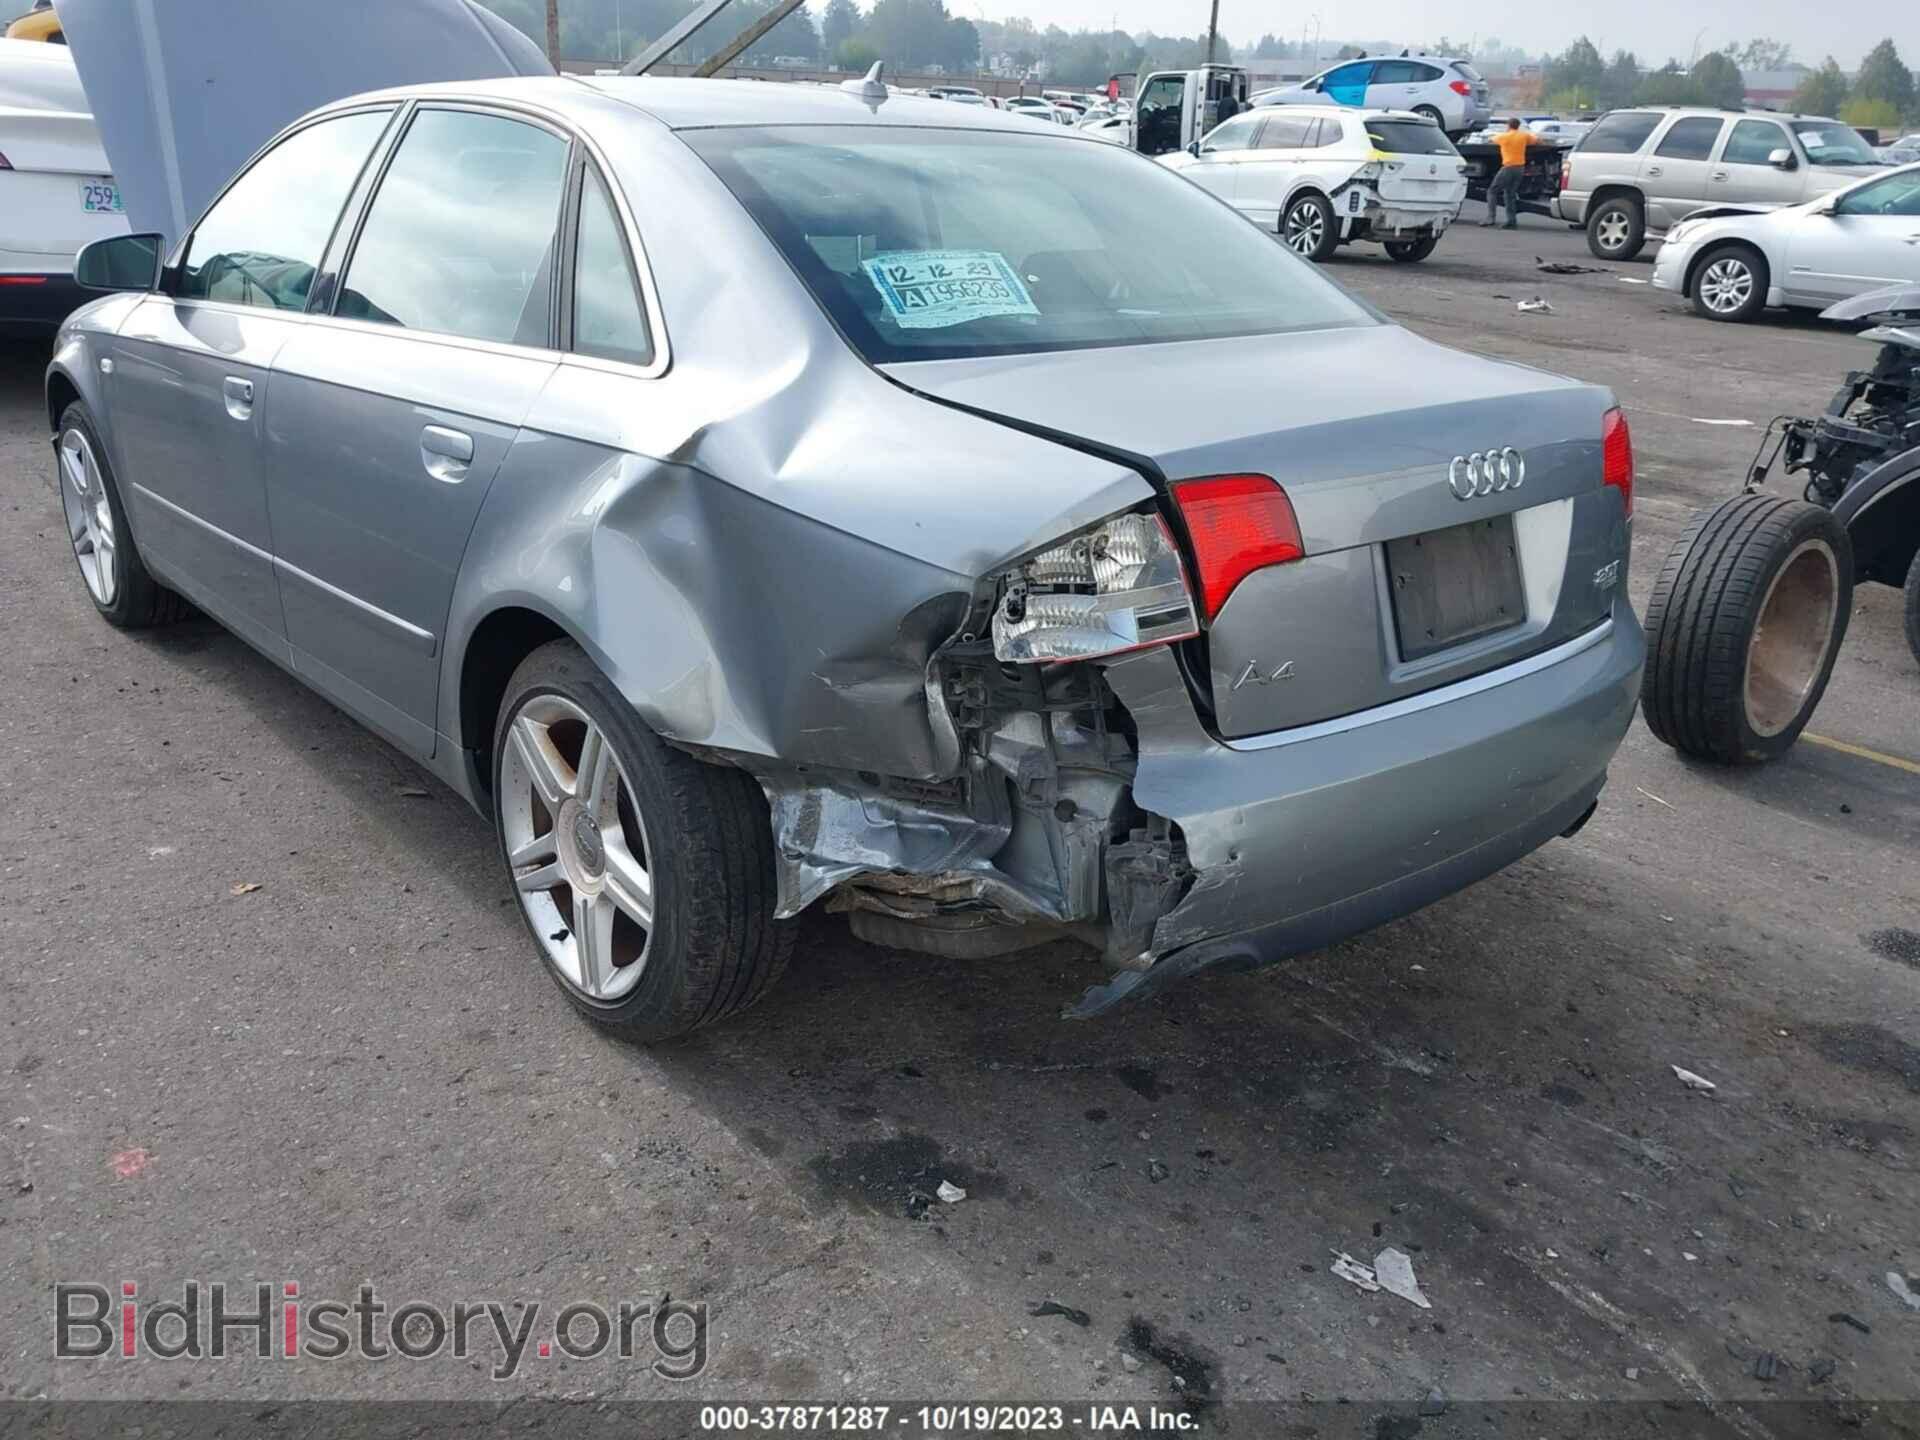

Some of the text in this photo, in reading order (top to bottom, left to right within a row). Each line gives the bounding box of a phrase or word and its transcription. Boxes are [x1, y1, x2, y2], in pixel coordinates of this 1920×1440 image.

[84, 186, 113, 205] 259
[888, 266, 915, 282] 12
[928, 263, 953, 278] 12
[967, 262, 992, 276] 23
[1232, 658, 1296, 691] A4
